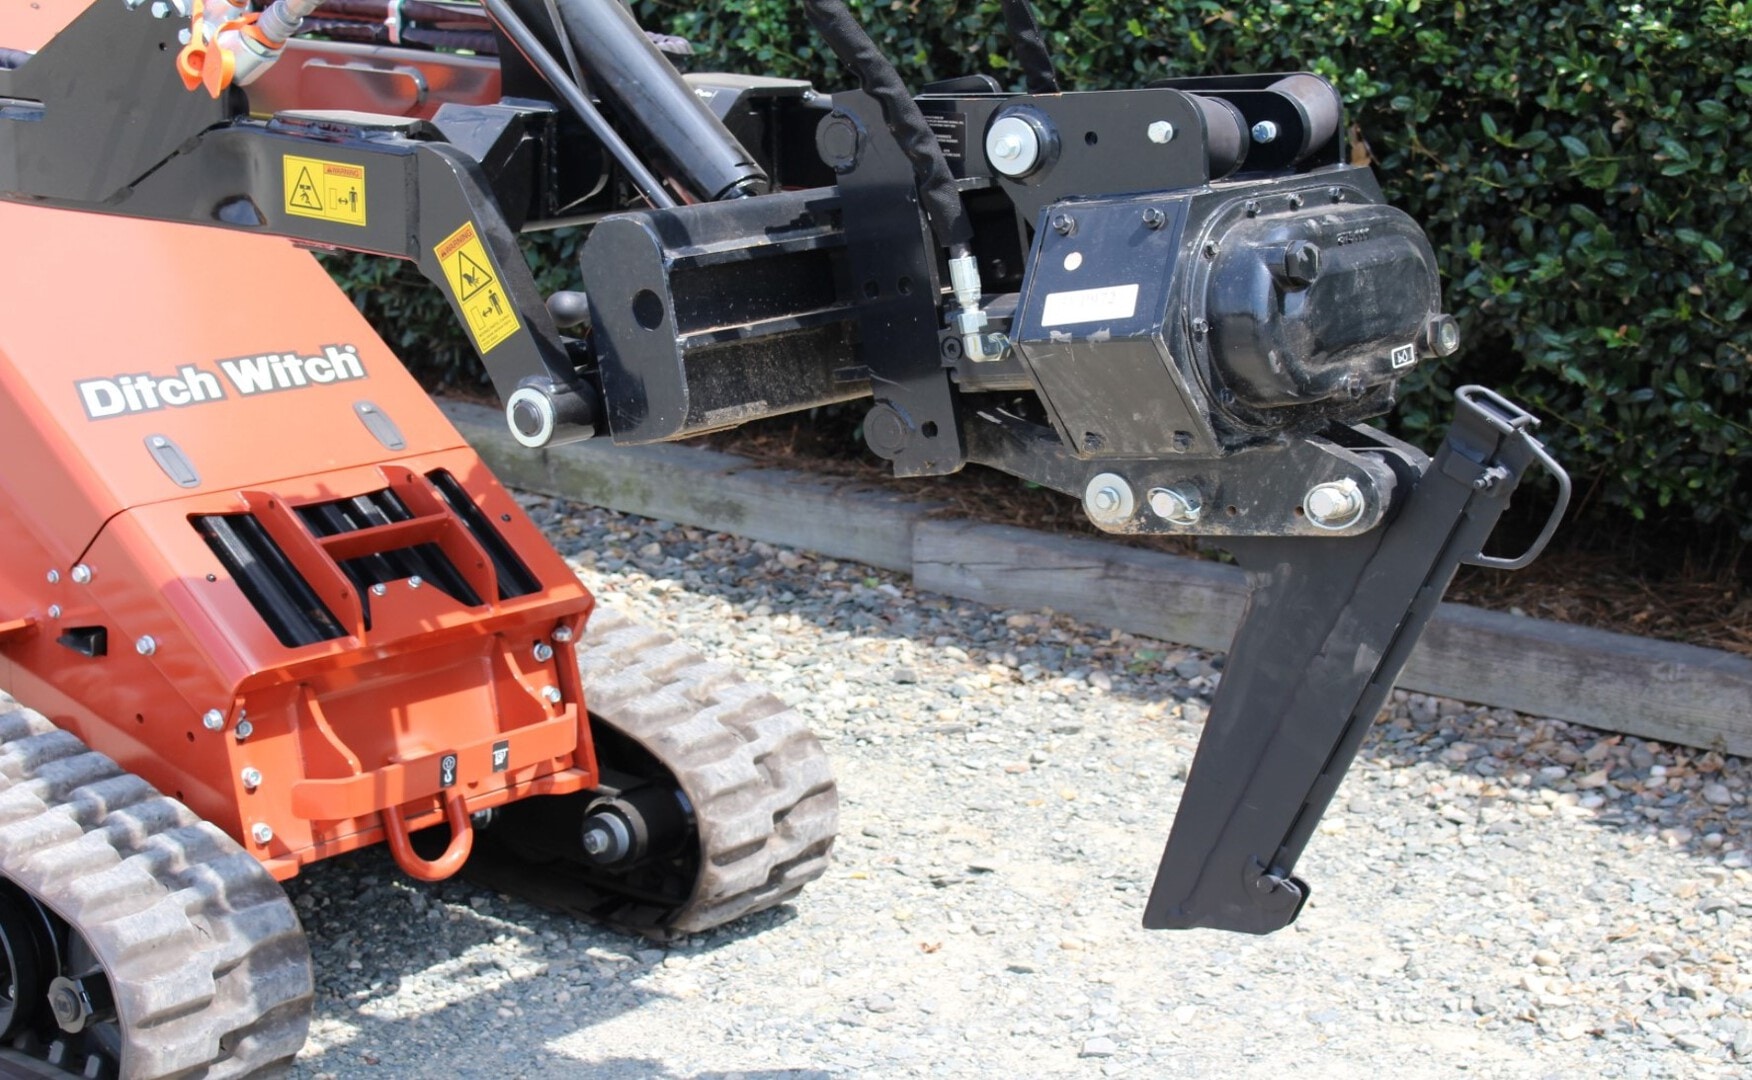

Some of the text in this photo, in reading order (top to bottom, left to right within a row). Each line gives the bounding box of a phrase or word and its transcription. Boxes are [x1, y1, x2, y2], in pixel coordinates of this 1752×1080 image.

[331, 167, 359, 178] WARNING
[445, 228, 473, 253] WARNING
[80, 346, 364, 417] Ditch Witch
